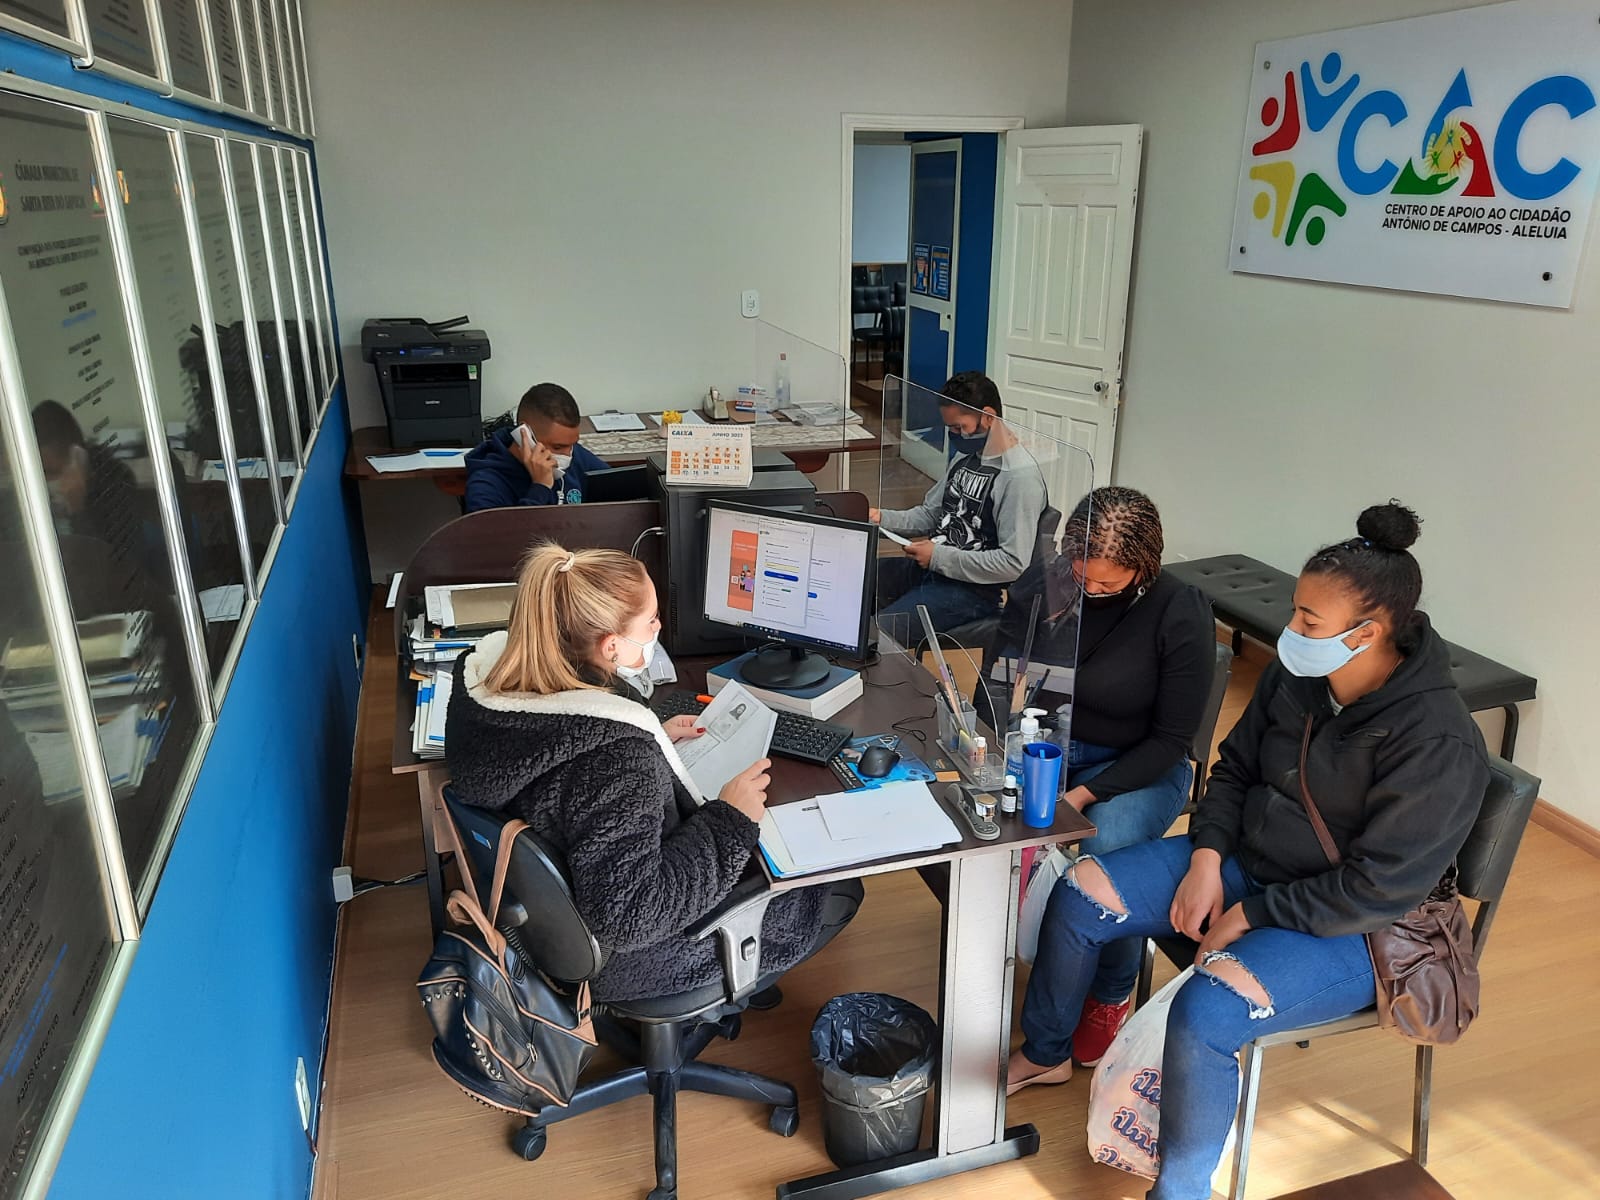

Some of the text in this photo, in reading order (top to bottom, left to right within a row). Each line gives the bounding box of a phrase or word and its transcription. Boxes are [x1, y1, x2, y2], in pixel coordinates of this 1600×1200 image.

[1337, 67, 1597, 201] CAC
[1385, 203, 1571, 223] CENTRO DE APOIO AO CIDADÃO
[1382, 215, 1431, 231] ANTÔNIO
[1433, 219, 1447, 232] DE
[1450, 221, 1502, 236] CAMPOS
[1512, 224, 1567, 239] ALELUIA
